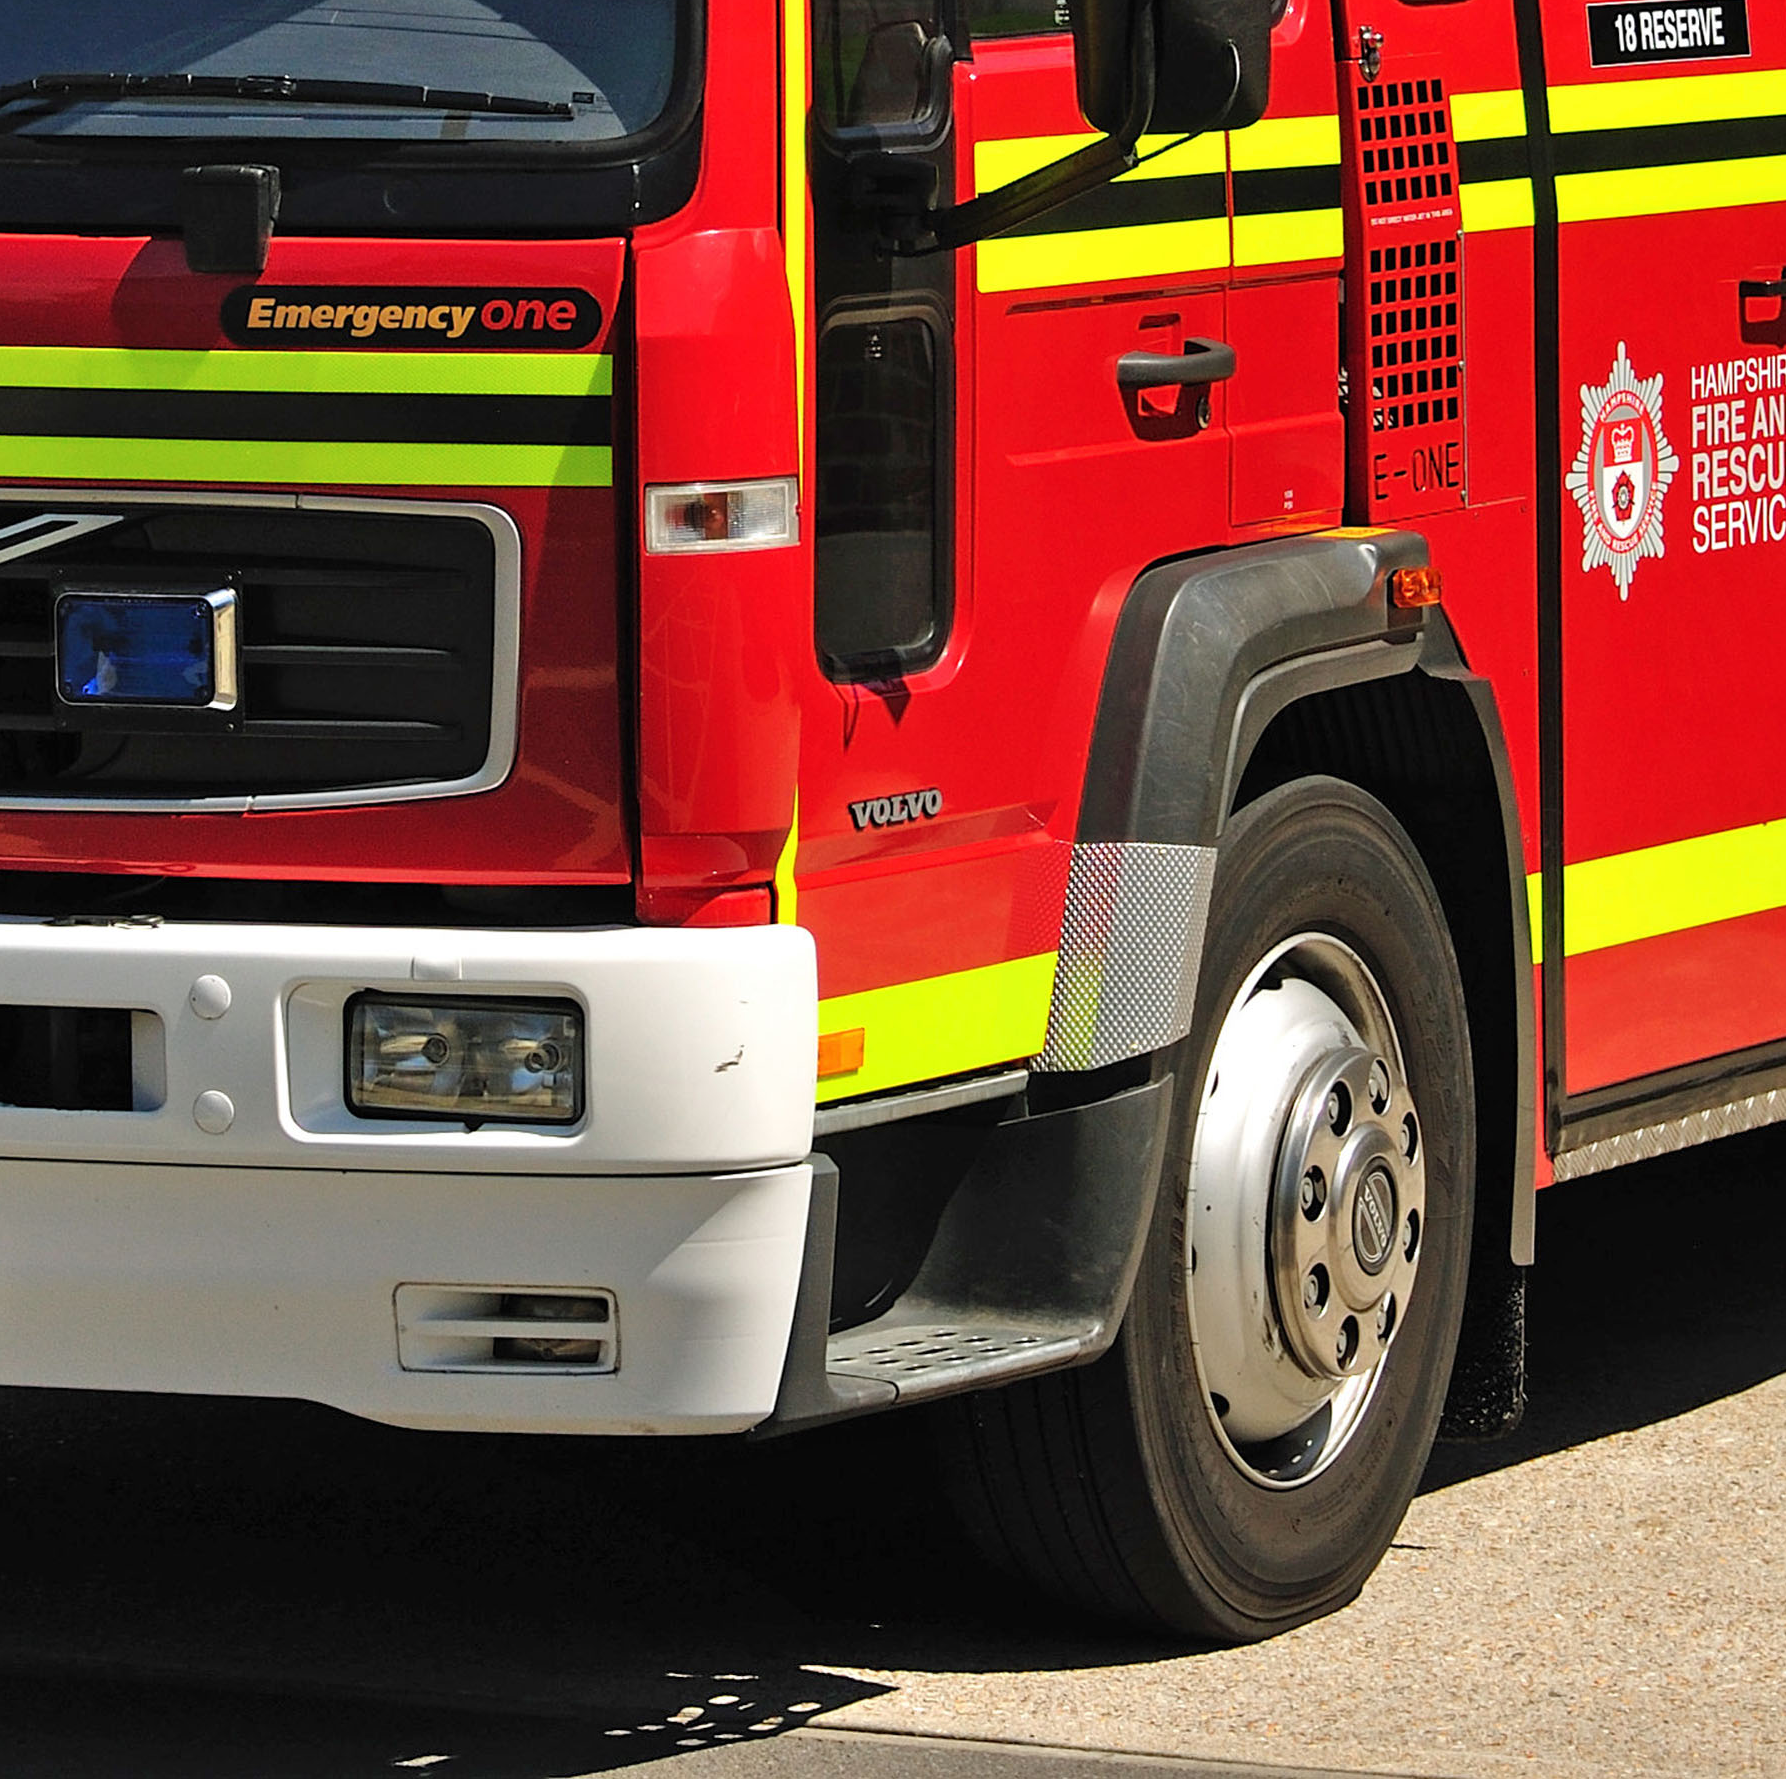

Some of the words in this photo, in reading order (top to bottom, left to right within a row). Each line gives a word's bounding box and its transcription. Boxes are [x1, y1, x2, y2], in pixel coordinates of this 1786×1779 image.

[1614, 13, 1638, 52] 18
[1639, 6, 1726, 50] RESERVE
[246, 297, 477, 338] Emergency
[480, 299, 577, 331] one
[1691, 399, 1747, 449] FIRE
[1374, 441, 1460, 500] E-ONE
[850, 788, 943, 829] VOLVO
[1364, 1183, 1388, 1249] VOLVO
